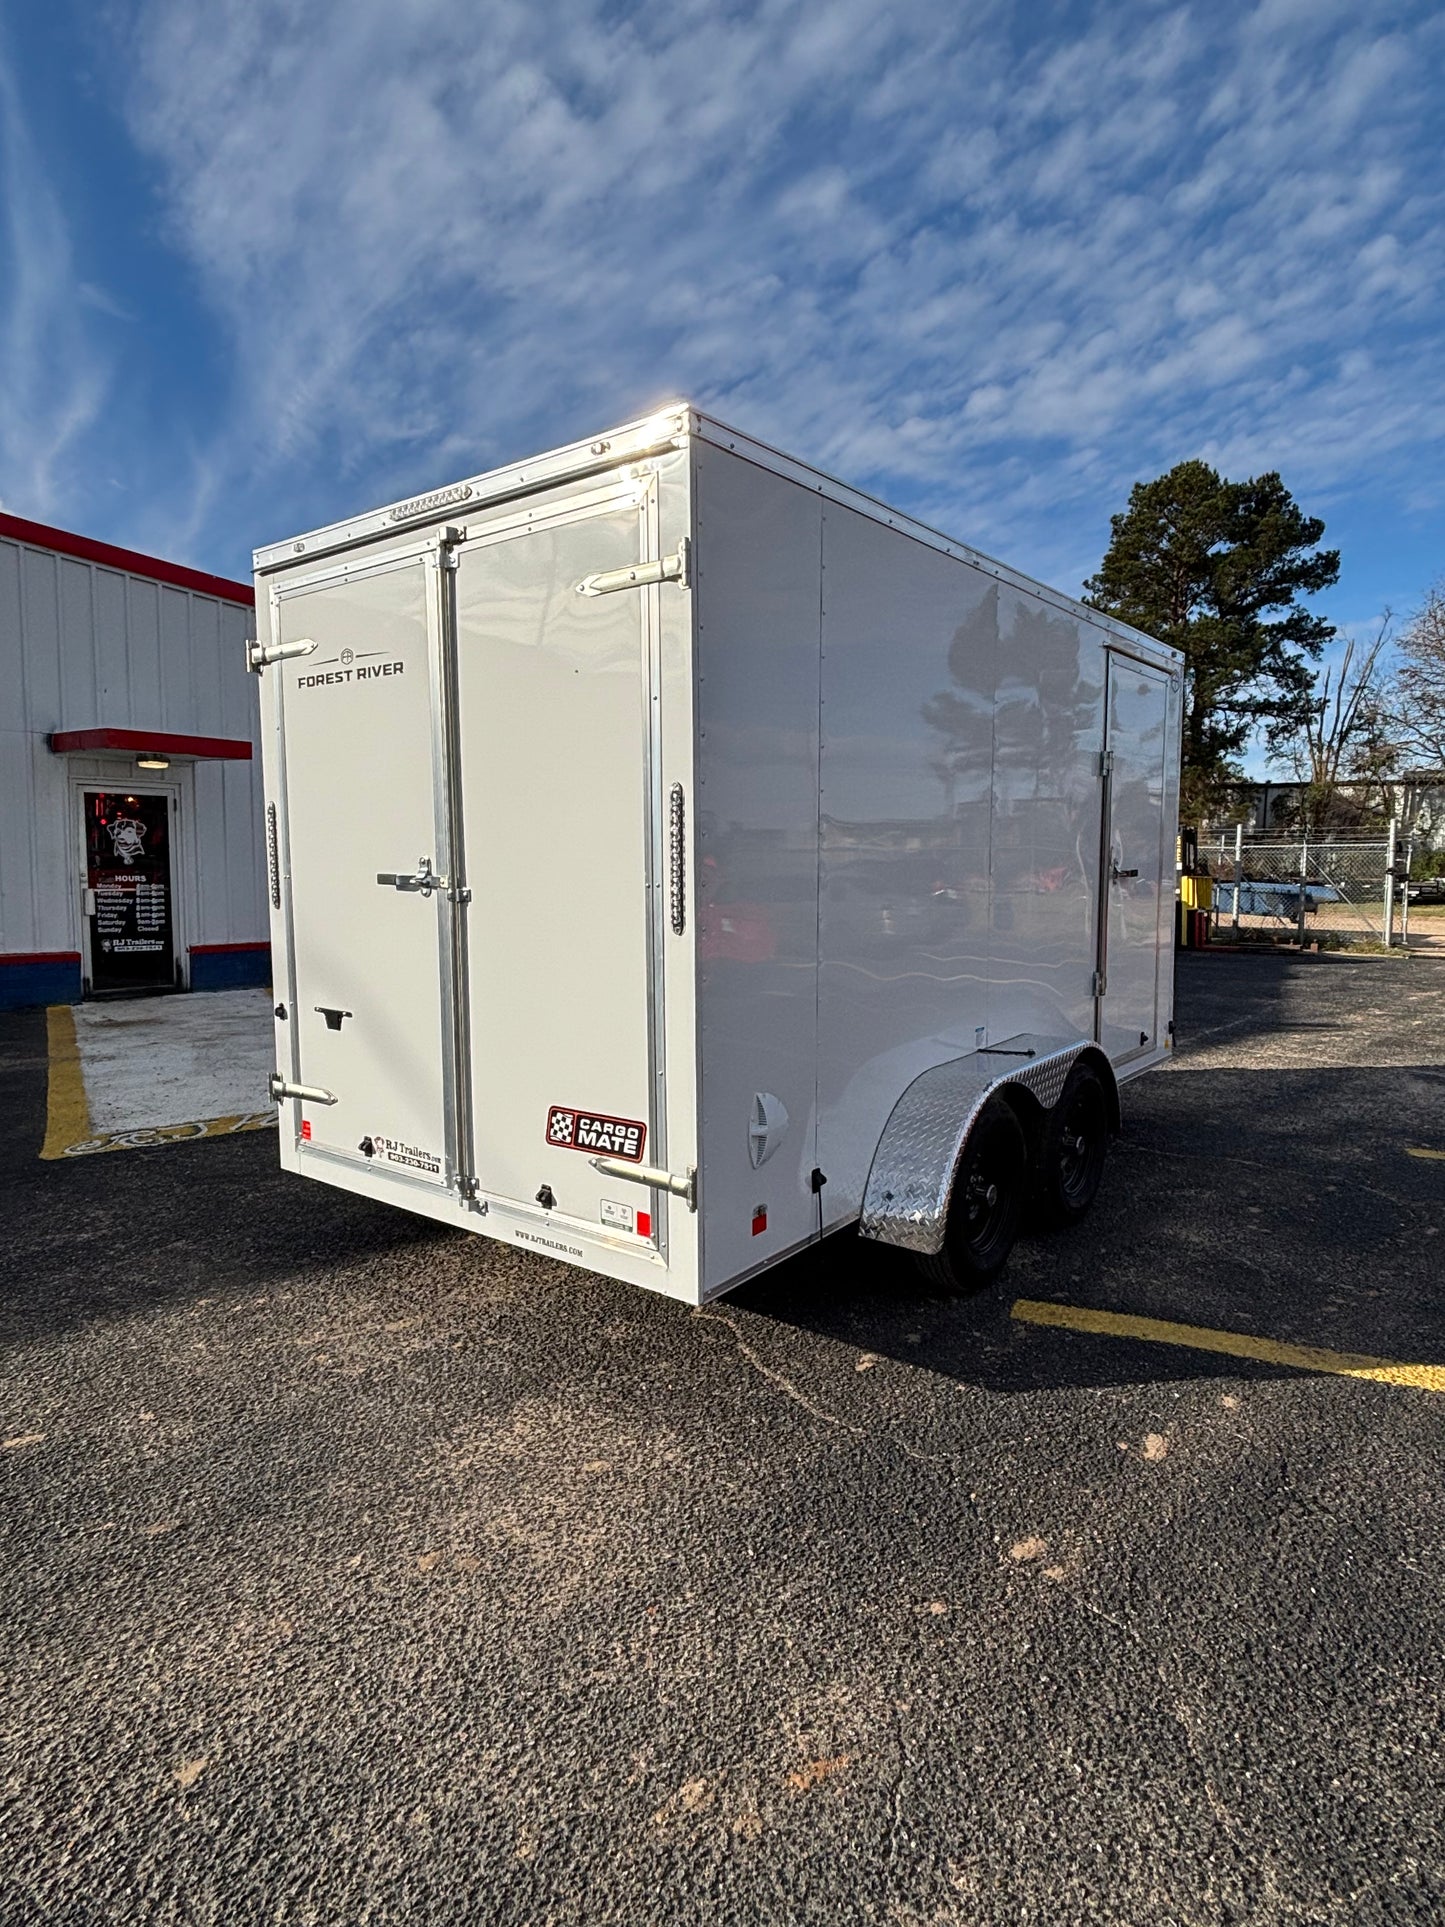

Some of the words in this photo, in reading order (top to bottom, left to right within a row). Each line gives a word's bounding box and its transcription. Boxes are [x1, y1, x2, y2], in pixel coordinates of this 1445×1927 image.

[297, 669, 353, 689] FOREST
[356, 661, 404, 680] RIVER
[580, 1118, 639, 1139] CARGO
[385, 1139, 398, 1151] RJ
[578, 1129, 637, 1155] MATE
